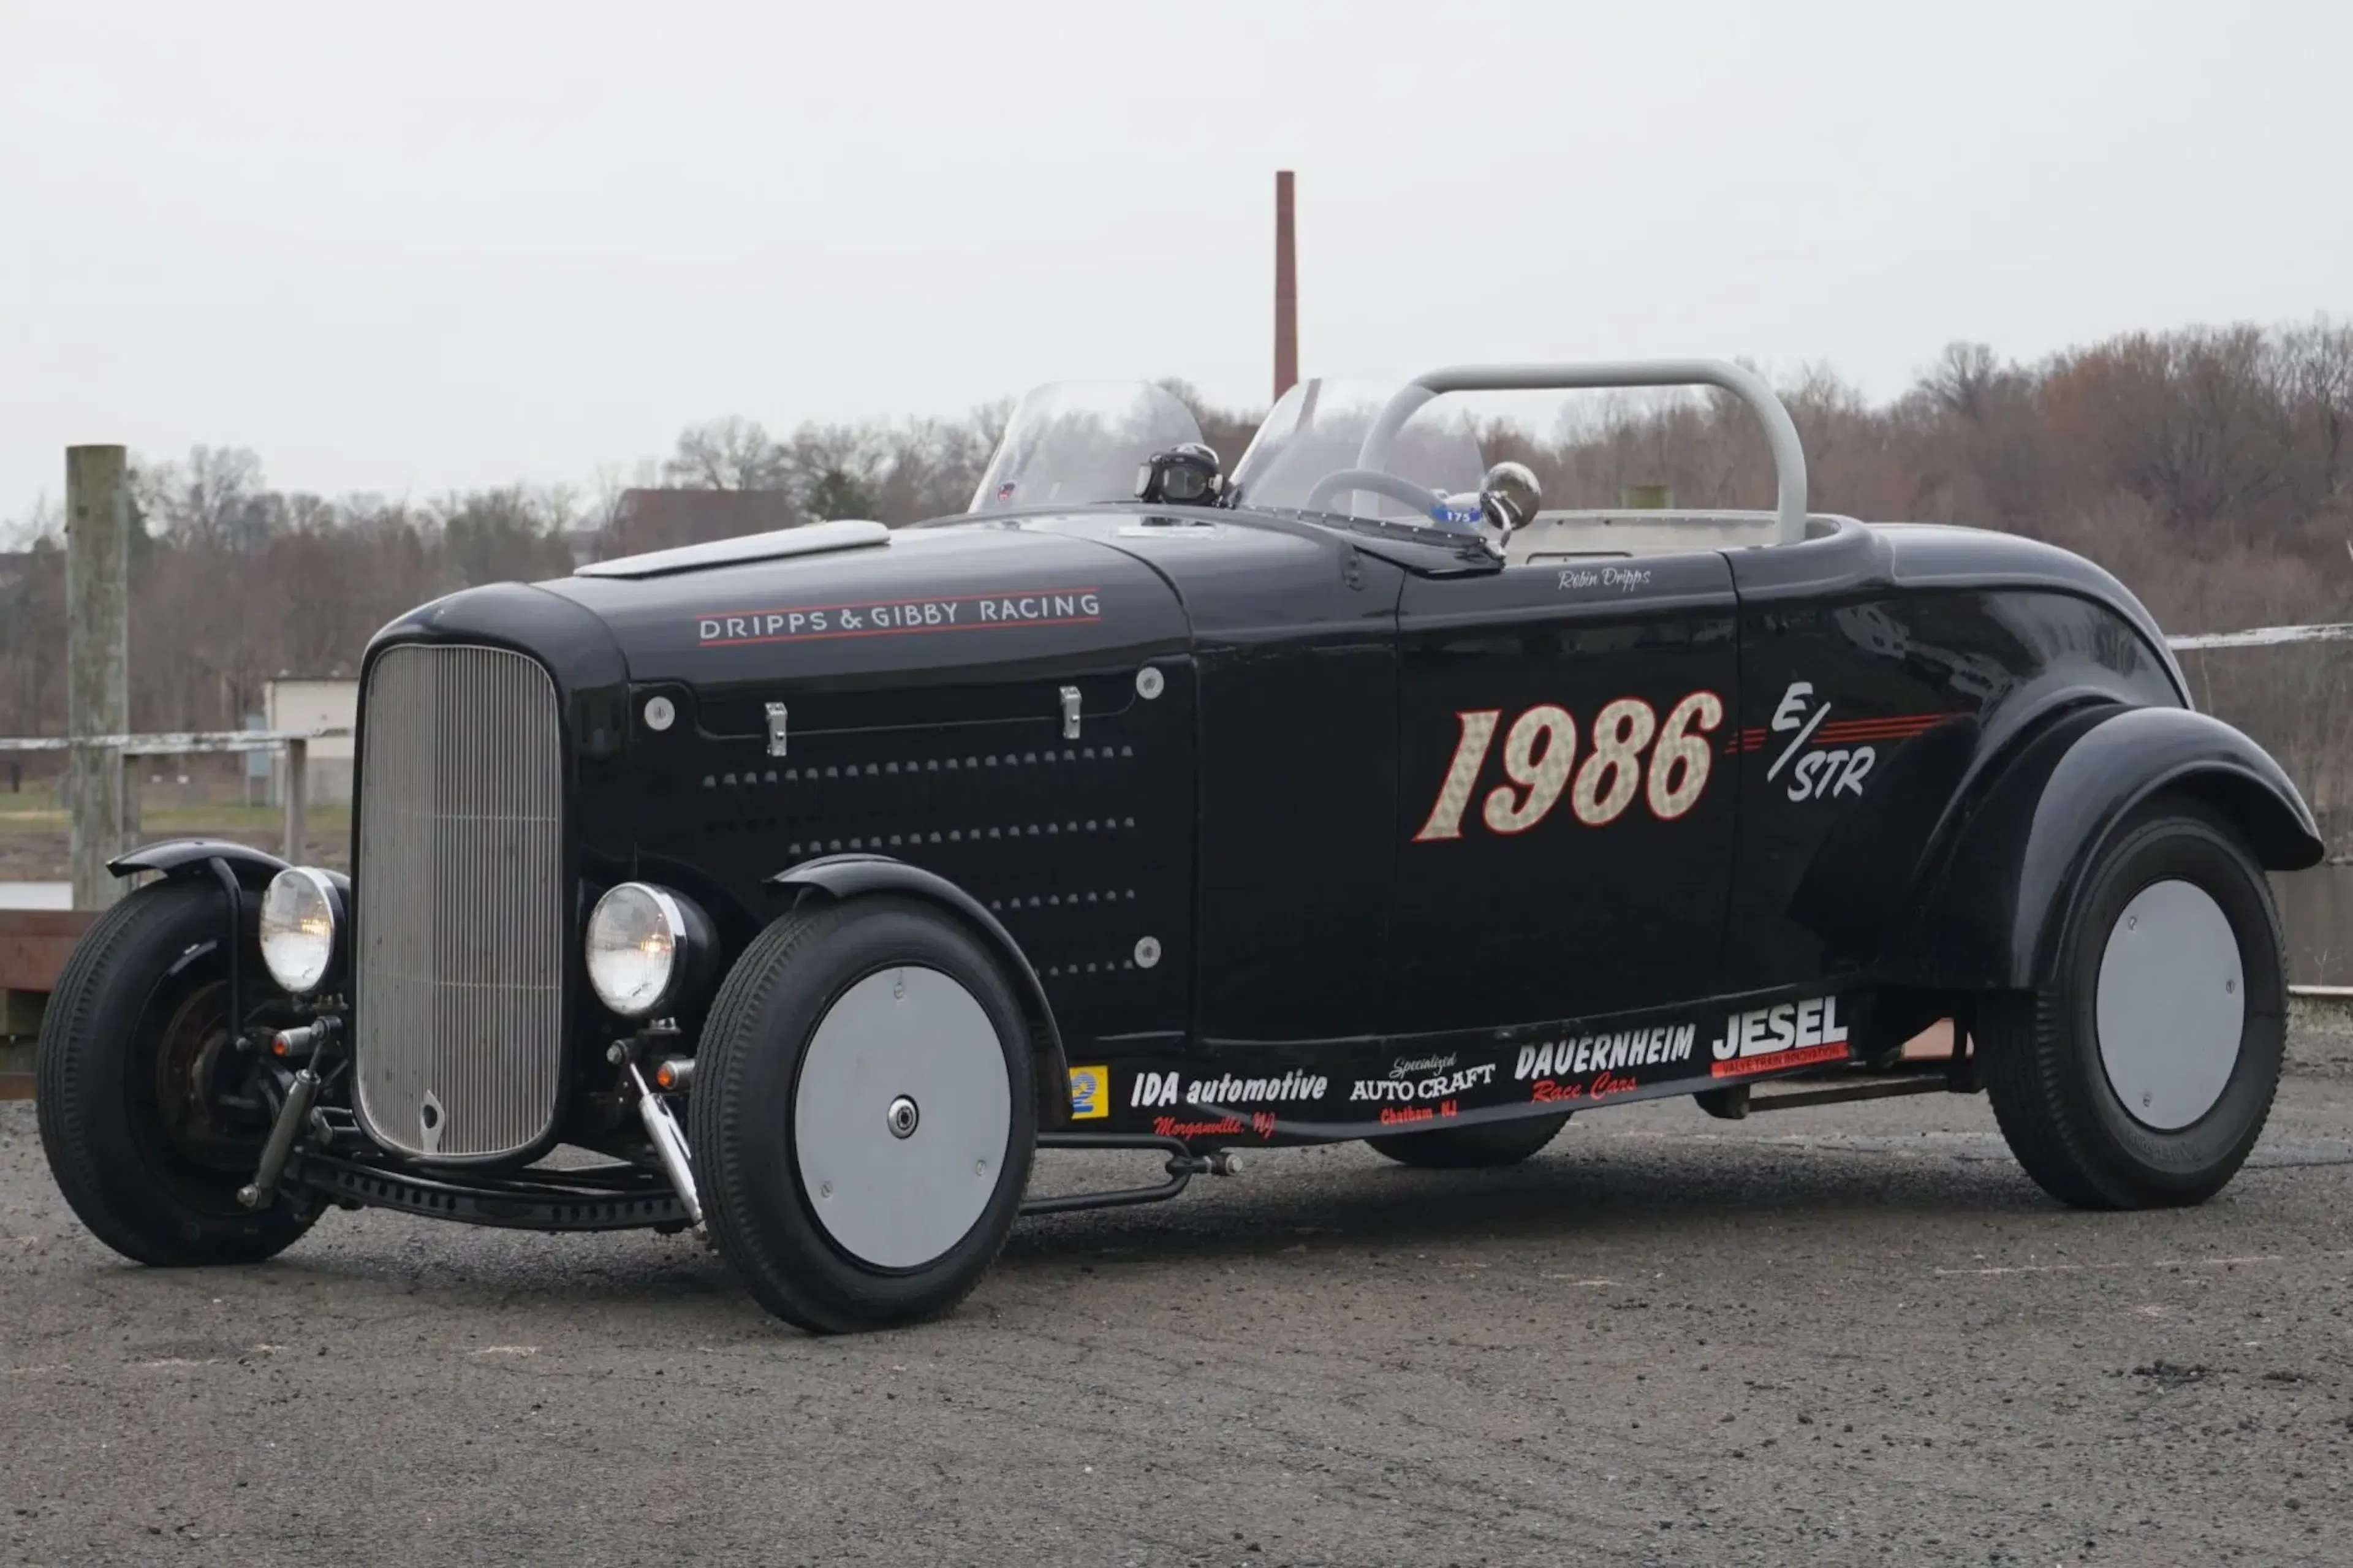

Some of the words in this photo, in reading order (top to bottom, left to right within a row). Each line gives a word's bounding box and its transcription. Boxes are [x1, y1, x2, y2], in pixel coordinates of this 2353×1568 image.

[1558, 570, 1598, 591] Robin
[1601, 567, 1651, 593] Dripps
[699, 612, 828, 639] DRIPPS
[839, 608, 862, 629] &
[871, 602, 958, 627] GIBBY
[980, 594, 1101, 622] RACING
[1412, 690, 1723, 842] 1986
[1712, 996, 1849, 1060] JESEL
[1389, 1051, 1457, 1080] Specialized
[1514, 1023, 1697, 1080] DAUERNHEIM
[1130, 1071, 1180, 1108] IDA
[1186, 1068, 1328, 1105] automotive
[1531, 1079, 1582, 1104] Race
[1589, 1070, 1637, 1100] Cars
[1380, 1107, 1434, 1126] Chatham
[1439, 1100, 1458, 1118] NJ
